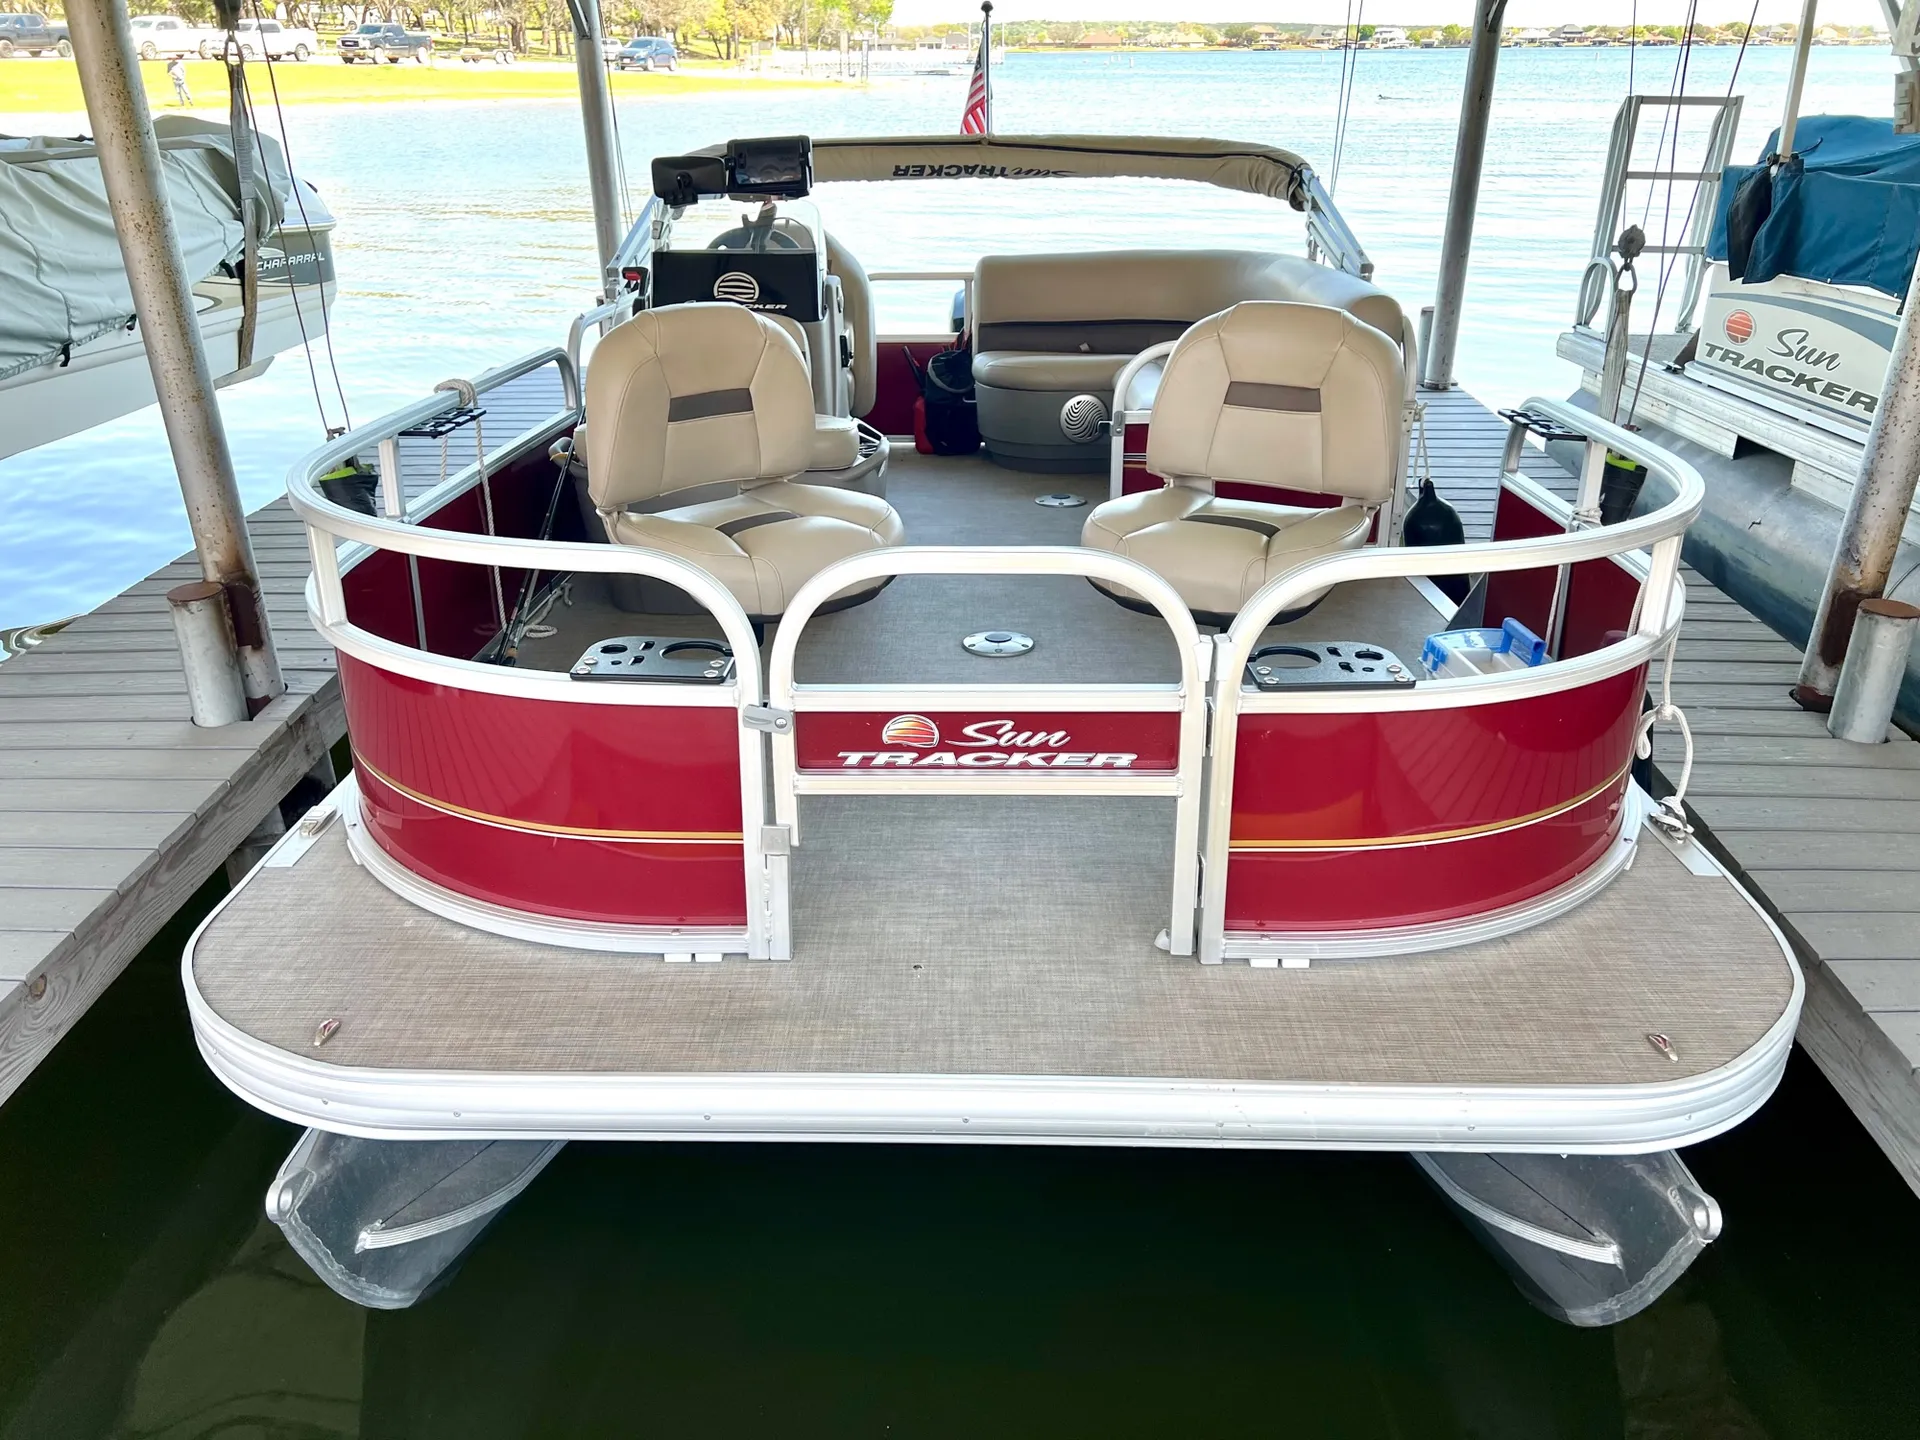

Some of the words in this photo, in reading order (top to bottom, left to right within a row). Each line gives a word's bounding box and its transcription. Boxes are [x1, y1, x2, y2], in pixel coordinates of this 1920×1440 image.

[893, 164, 1009, 178] TRACKER
[742, 303, 788, 311] CKER
[1766, 328, 1841, 372] Sun
[1705, 342, 1879, 414] TRACKER
[945, 719, 1071, 748] Sun
[837, 751, 1138, 768] TRACKER
